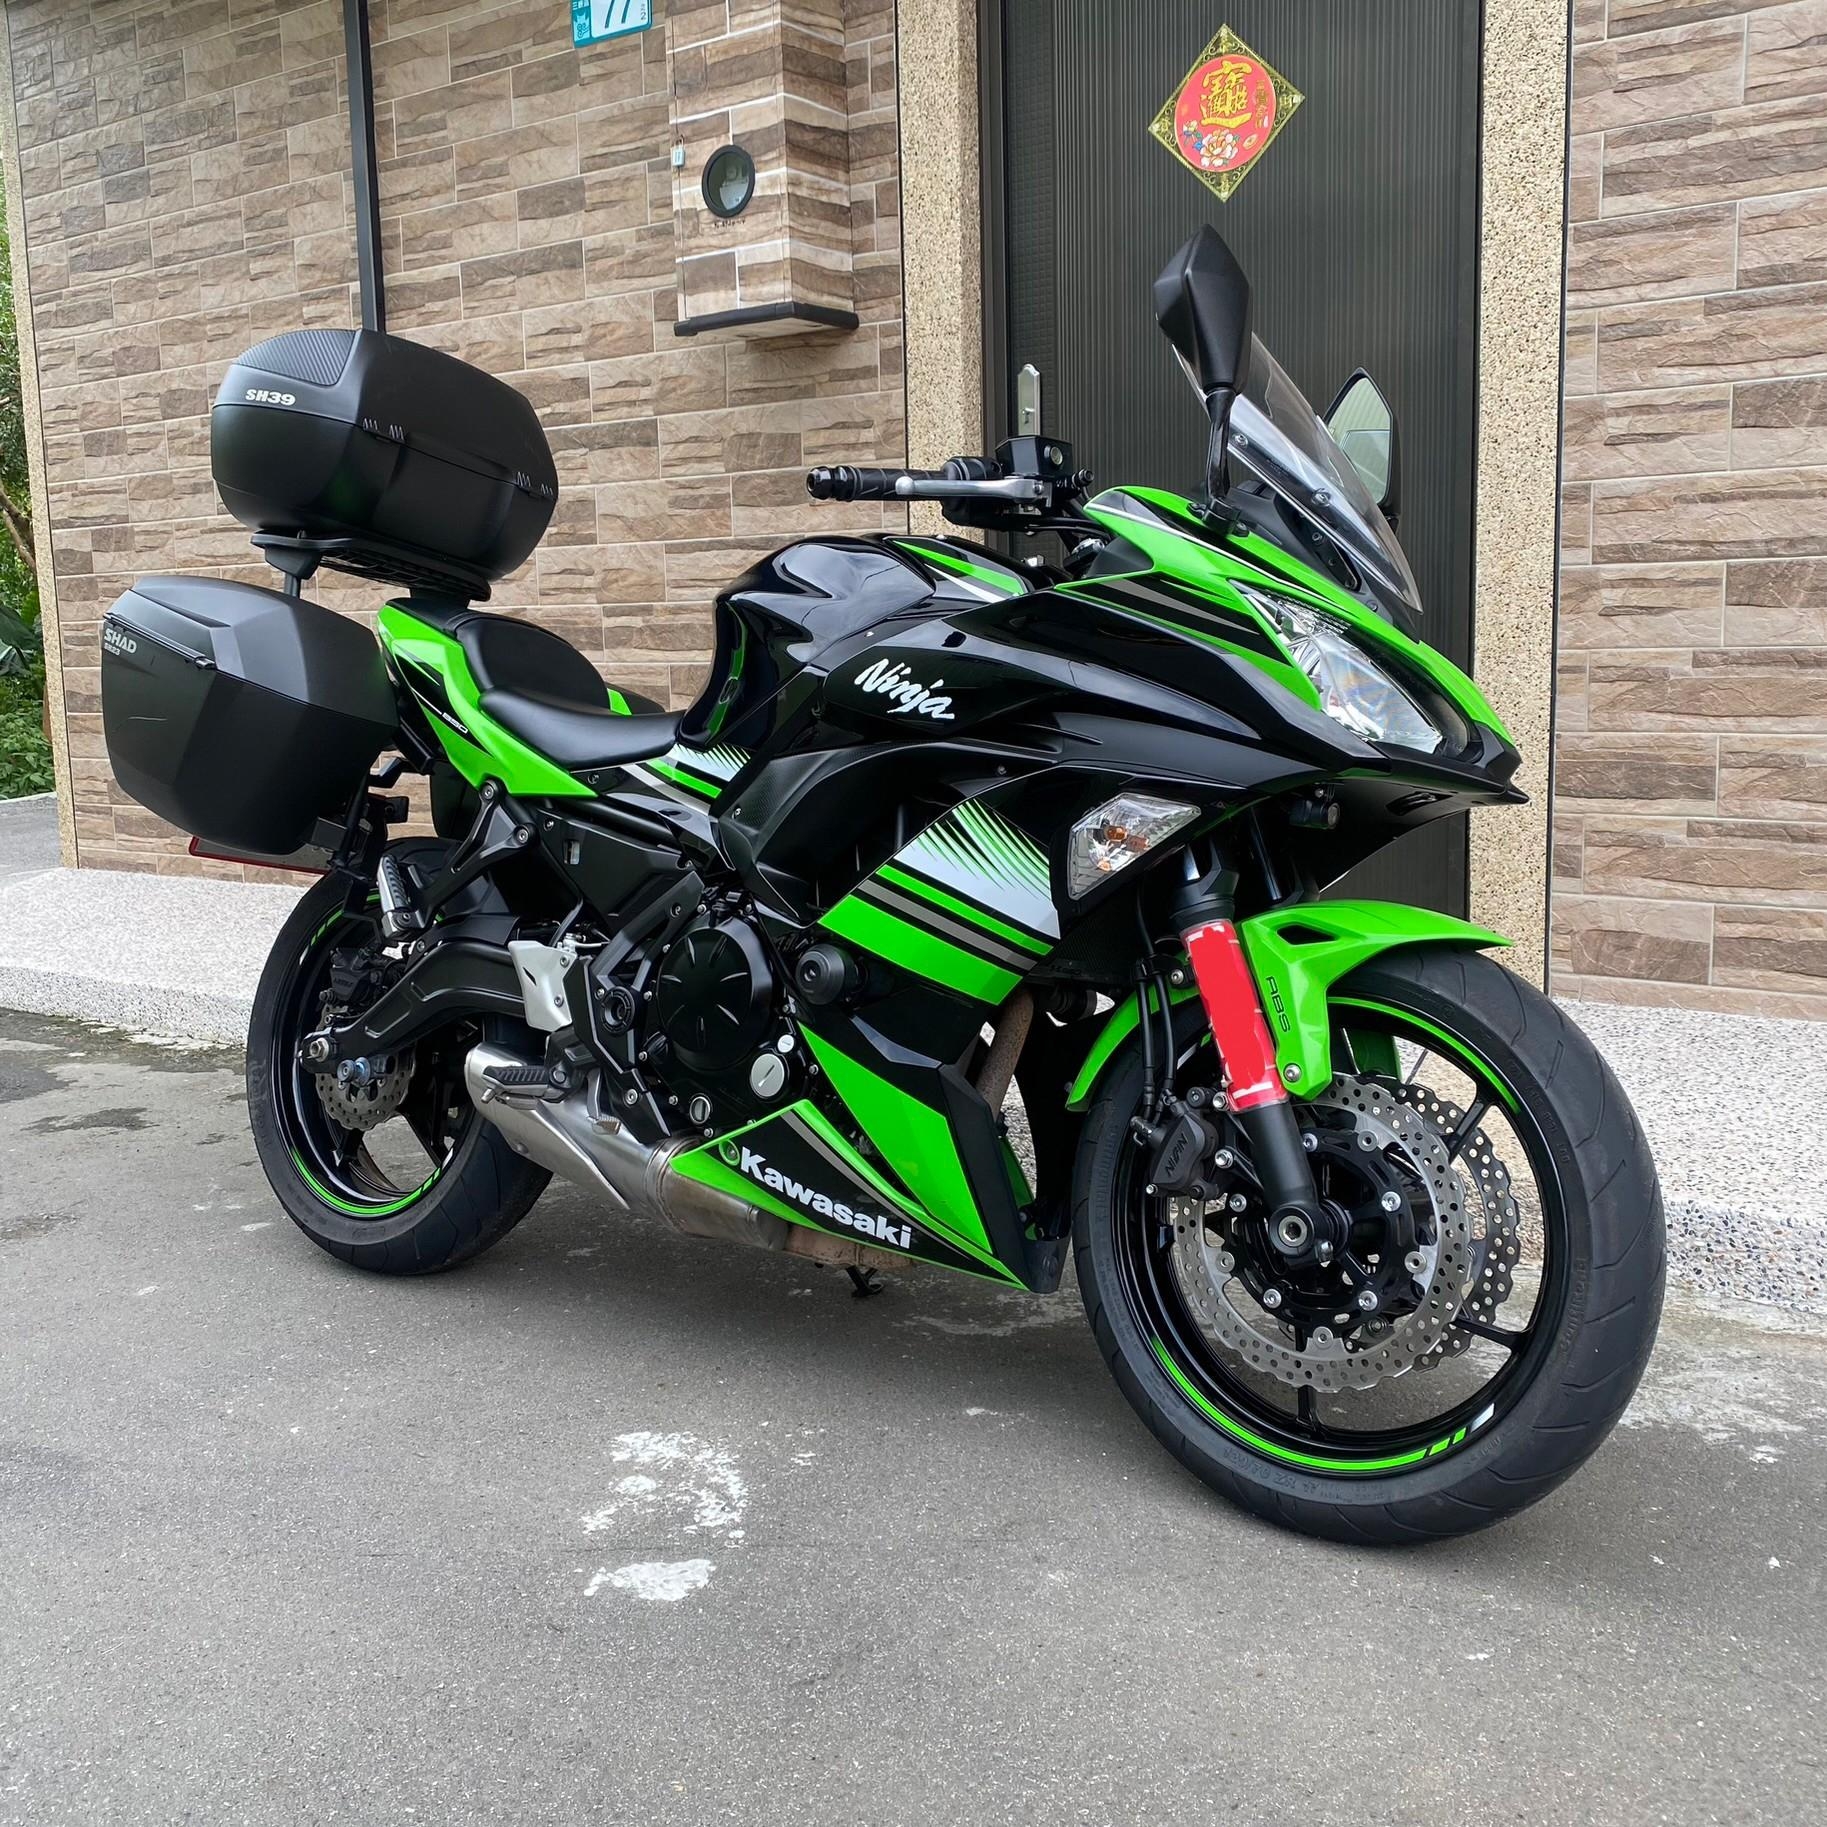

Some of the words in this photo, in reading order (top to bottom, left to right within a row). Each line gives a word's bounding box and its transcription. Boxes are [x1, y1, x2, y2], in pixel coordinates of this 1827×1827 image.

[245, 388, 296, 406] SH39
[104, 627, 137, 654] SHAD
[853, 658, 955, 719] Ninja
[1265, 975, 1291, 1033] ABS
[740, 1146, 912, 1250] Kawasaki
